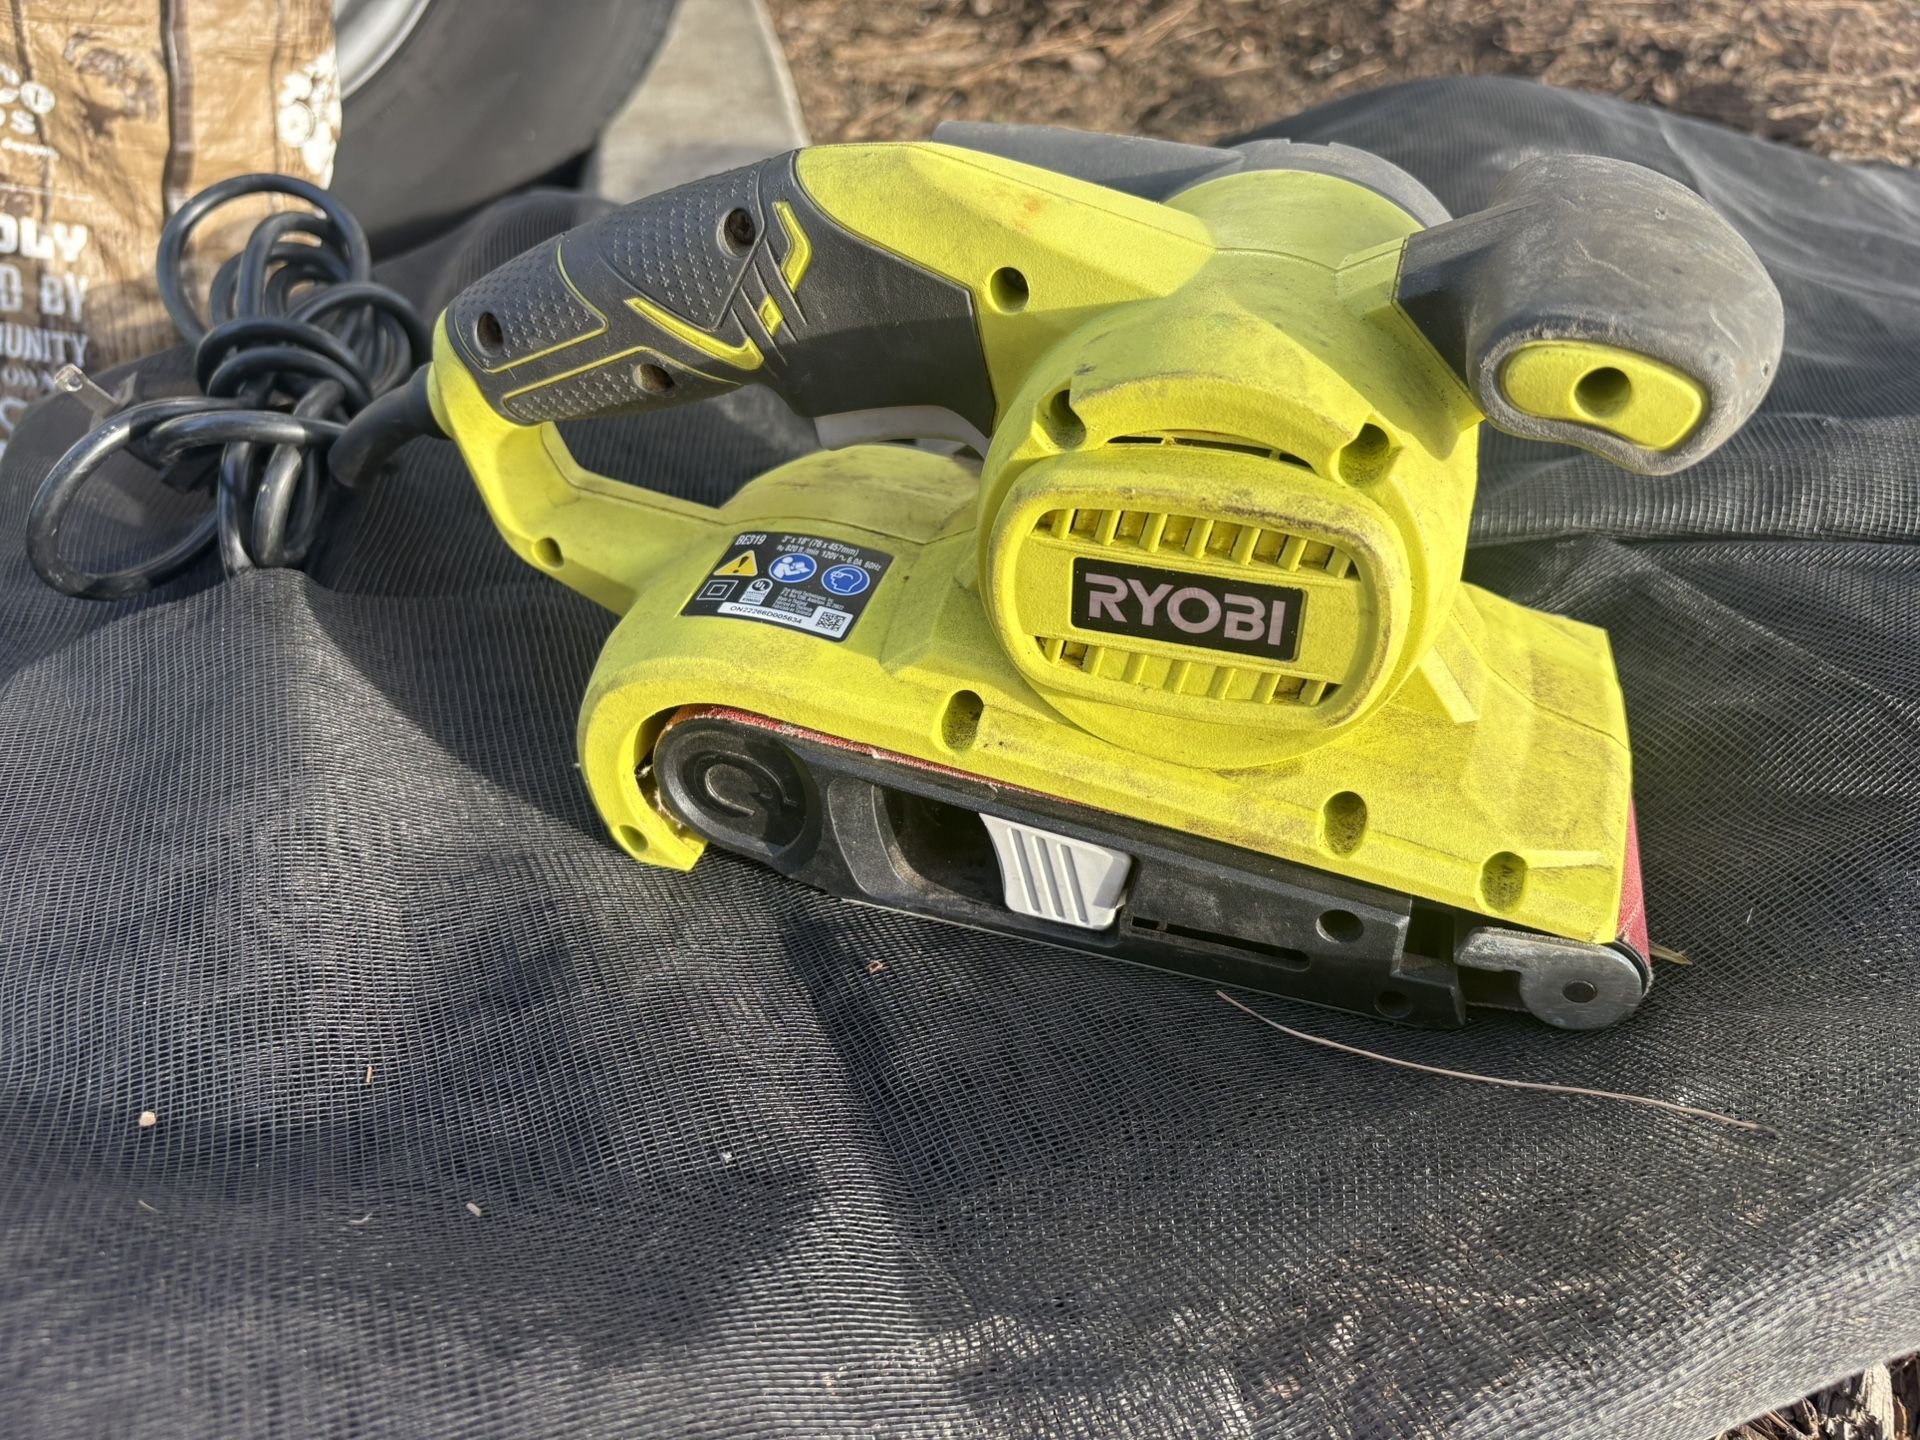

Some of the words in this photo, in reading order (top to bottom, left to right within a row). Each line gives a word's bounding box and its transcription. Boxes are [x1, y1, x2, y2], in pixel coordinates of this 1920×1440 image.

[41, 270, 89, 322] BY
[0, 322, 88, 368] UNITY
[735, 534, 767, 545] BE319
[808, 538, 822, 548] (76
[828, 542, 860, 557] 457mm)
[821, 550, 840, 560] 120V
[864, 560, 882, 571] 60Hz
[1085, 572, 1286, 646] RYOBI
